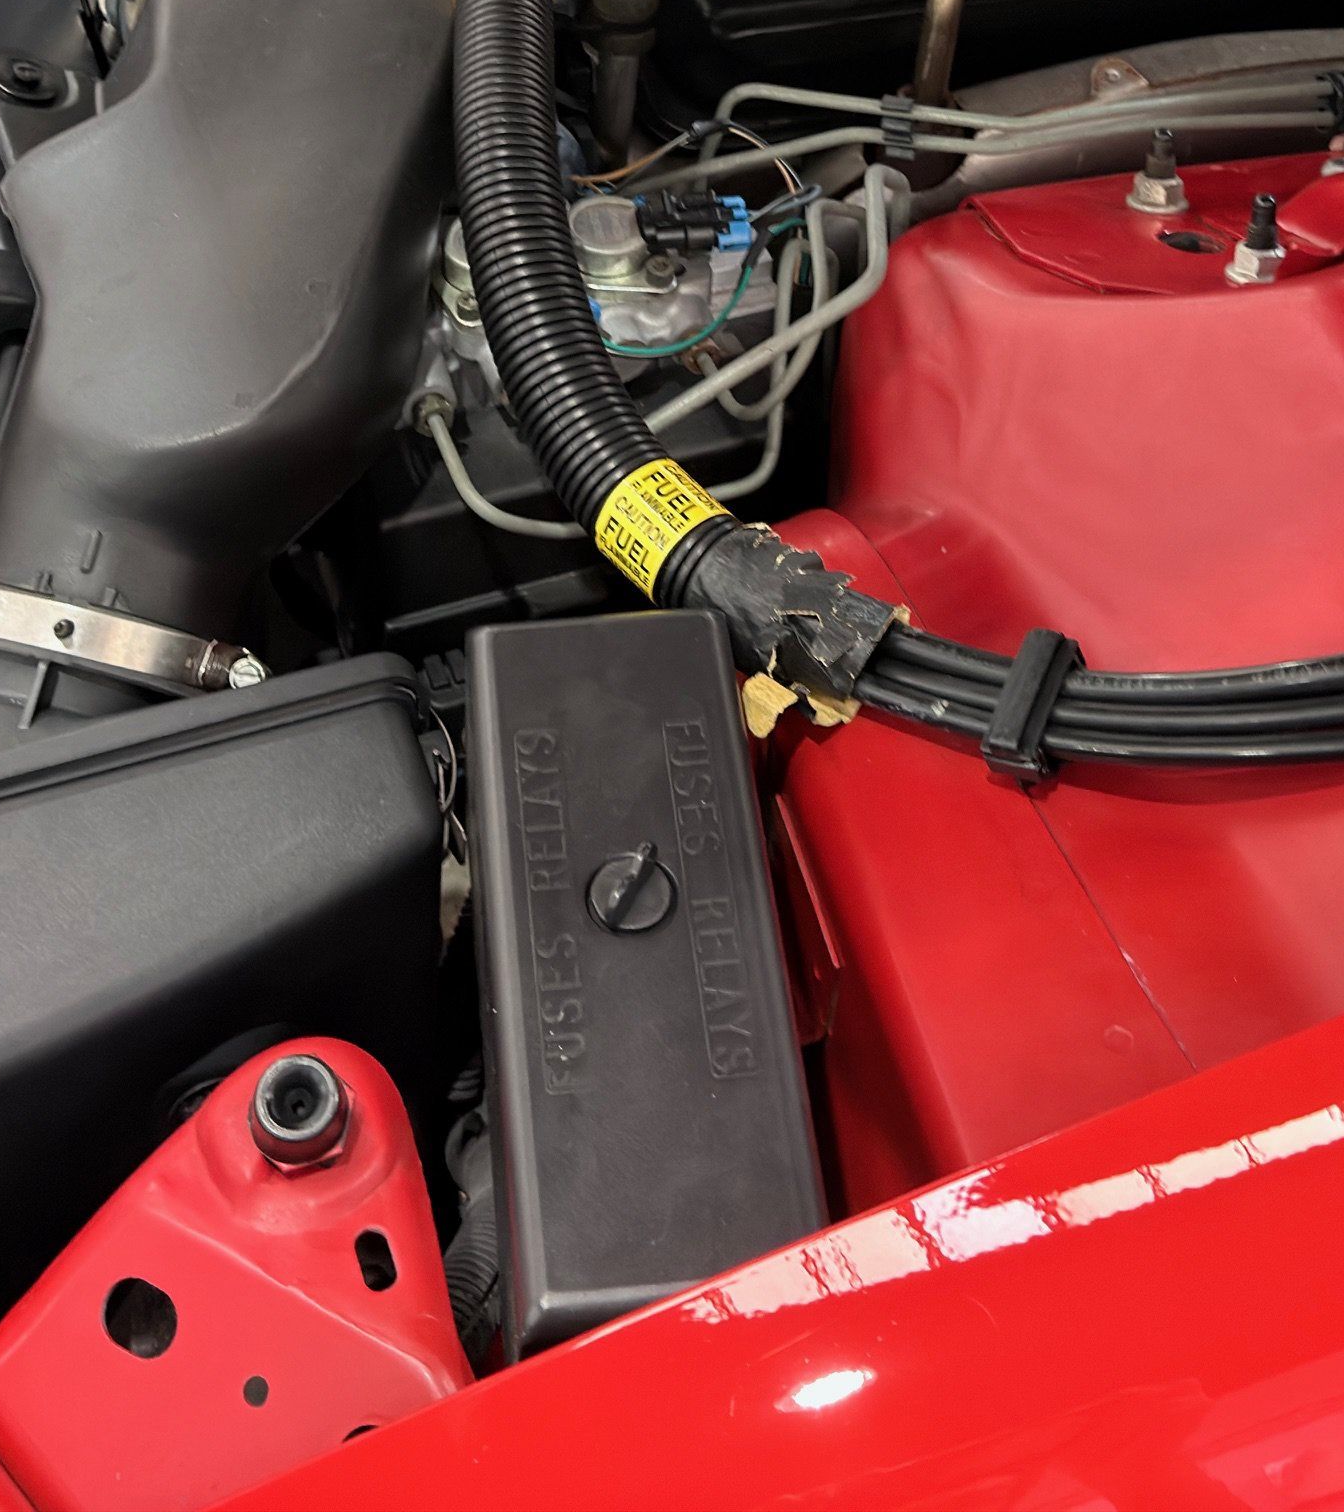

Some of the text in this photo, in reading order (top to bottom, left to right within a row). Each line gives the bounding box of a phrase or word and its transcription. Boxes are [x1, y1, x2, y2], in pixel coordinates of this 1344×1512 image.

[630, 479, 686, 534] FLAMMABLE
[643, 471, 697, 522] FUEL
[664, 465, 718, 511] CAUTION
[603, 515, 651, 575] FUEL
[615, 496, 670, 551] CAUTION
[515, 728, 588, 1094] FUSES RELAYS
[664, 717, 758, 1077] FUSES RELAYS
